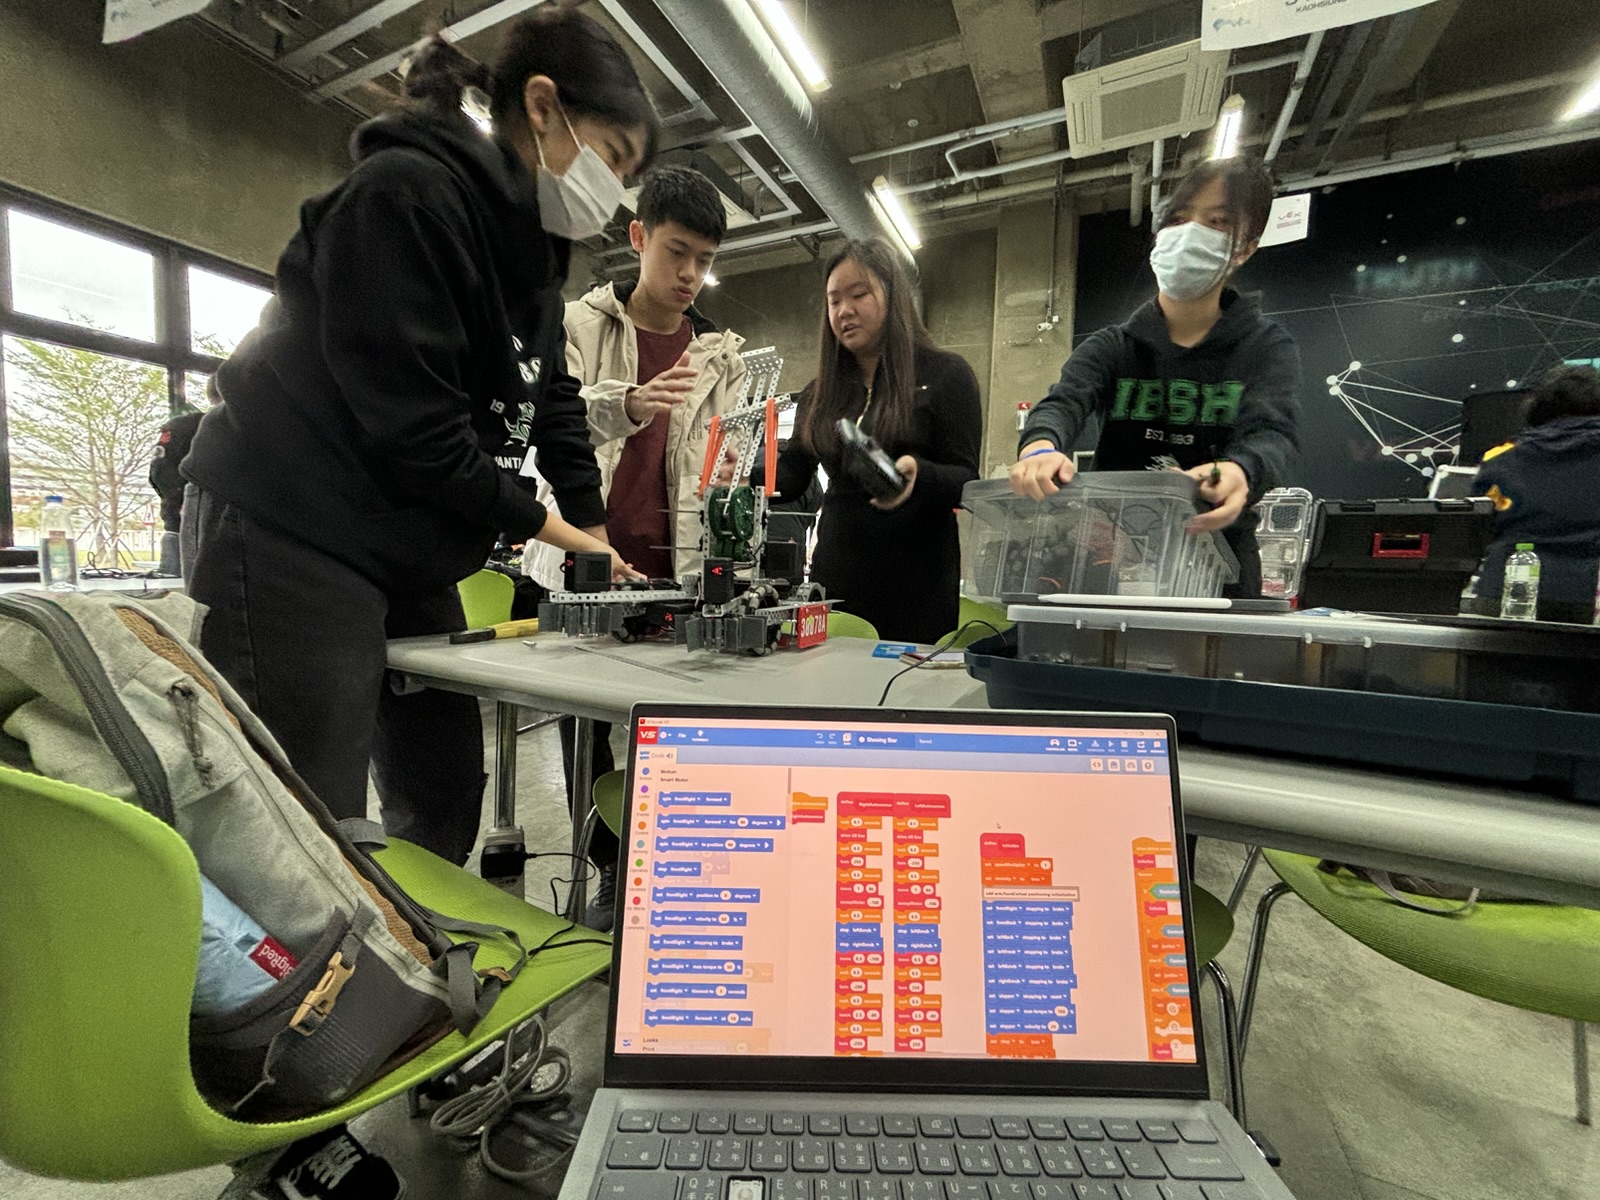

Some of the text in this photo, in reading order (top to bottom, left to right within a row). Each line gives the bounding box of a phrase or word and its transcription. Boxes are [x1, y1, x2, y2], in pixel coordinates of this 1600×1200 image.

[1110, 378, 1245, 425] IBSH
[757, 1154, 762, 1162] 3
[882, 1156, 888, 1164] 6
[924, 1157, 928, 1165] 7
[965, 1158, 972, 1166] 8
[1006, 1159, 1013, 1168] 9
[689, 1178, 698, 1188] Q
[777, 1179, 783, 1189] E
[820, 1180, 827, 1189] R
[865, 1181, 871, 1190] T
[908, 1182, 914, 1191] Y
[950, 1183, 959, 1193] U
[1080, 1185, 1087, 1194] P
